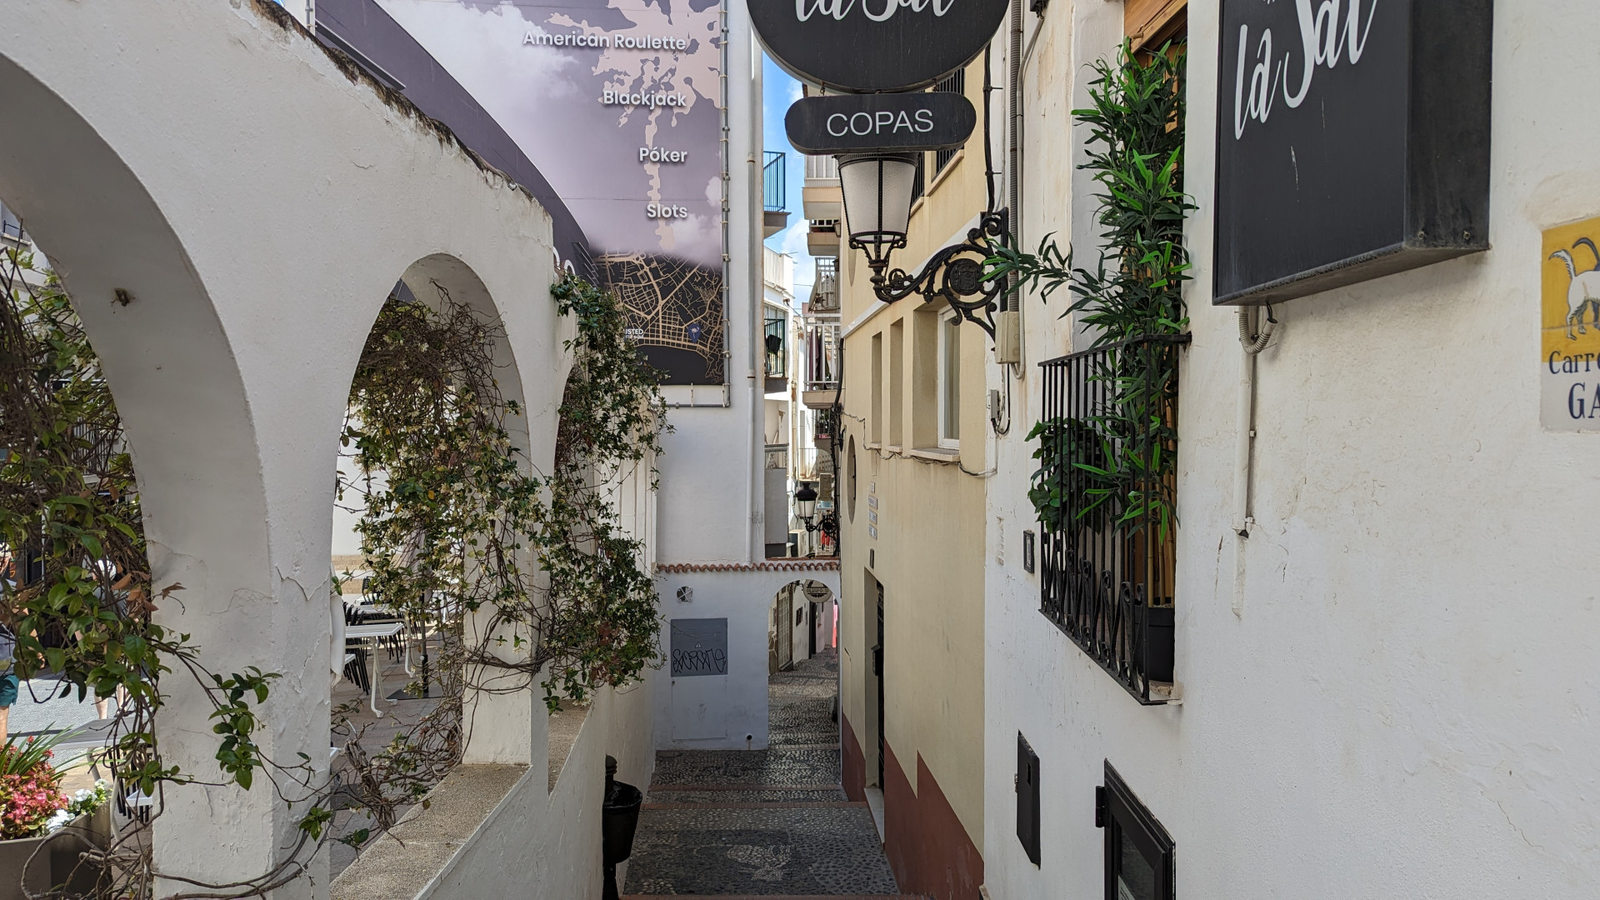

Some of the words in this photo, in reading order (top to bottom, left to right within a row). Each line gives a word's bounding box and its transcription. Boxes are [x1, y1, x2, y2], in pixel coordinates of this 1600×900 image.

[523, 31, 610, 48] American
[614, 34, 687, 50] Roulette
[1235, 24, 1282, 140] la
[603, 90, 687, 109] Blackjack
[826, 109, 934, 137] COPAS
[639, 147, 688, 163] Póker
[647, 203, 688, 218] Slots
